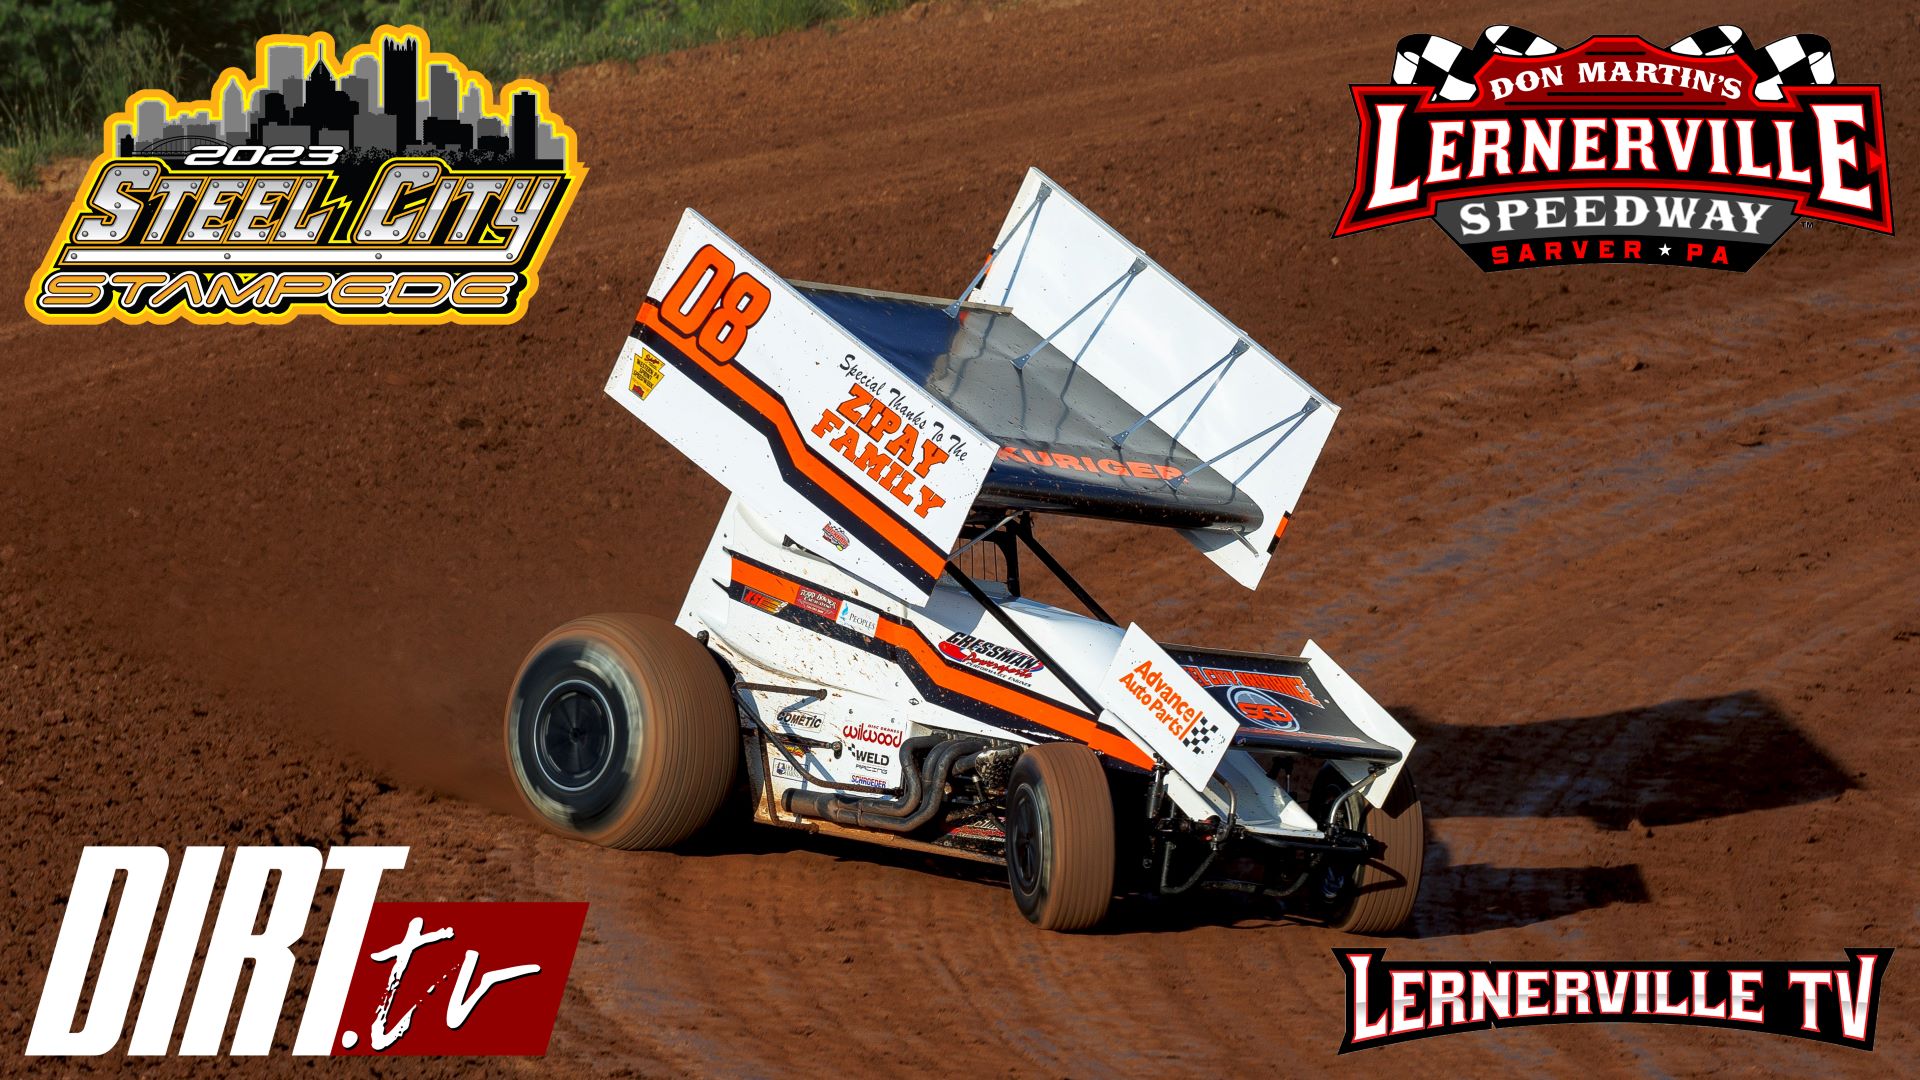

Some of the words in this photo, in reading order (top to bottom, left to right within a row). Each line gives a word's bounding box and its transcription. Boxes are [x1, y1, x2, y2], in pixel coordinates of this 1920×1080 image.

[658, 244, 771, 366] 08
[836, 383, 949, 479] ZIPAY
[839, 353, 887, 396] Special
[890, 388, 927, 430] Thanks
[932, 421, 945, 443] To
[948, 434, 968, 461] The
[811, 408, 946, 519] FAMILY
[946, 632, 1036, 669] GRESSMAN
[1202, 668, 1239, 686] CITY
[777, 711, 822, 728] COMETIC
[1119, 672, 1151, 705] Auto
[1148, 698, 1183, 736] Parts
[1134, 660, 1195, 722] Advance
[843, 722, 903, 748] wilwood
[856, 750, 890, 766] WELD
